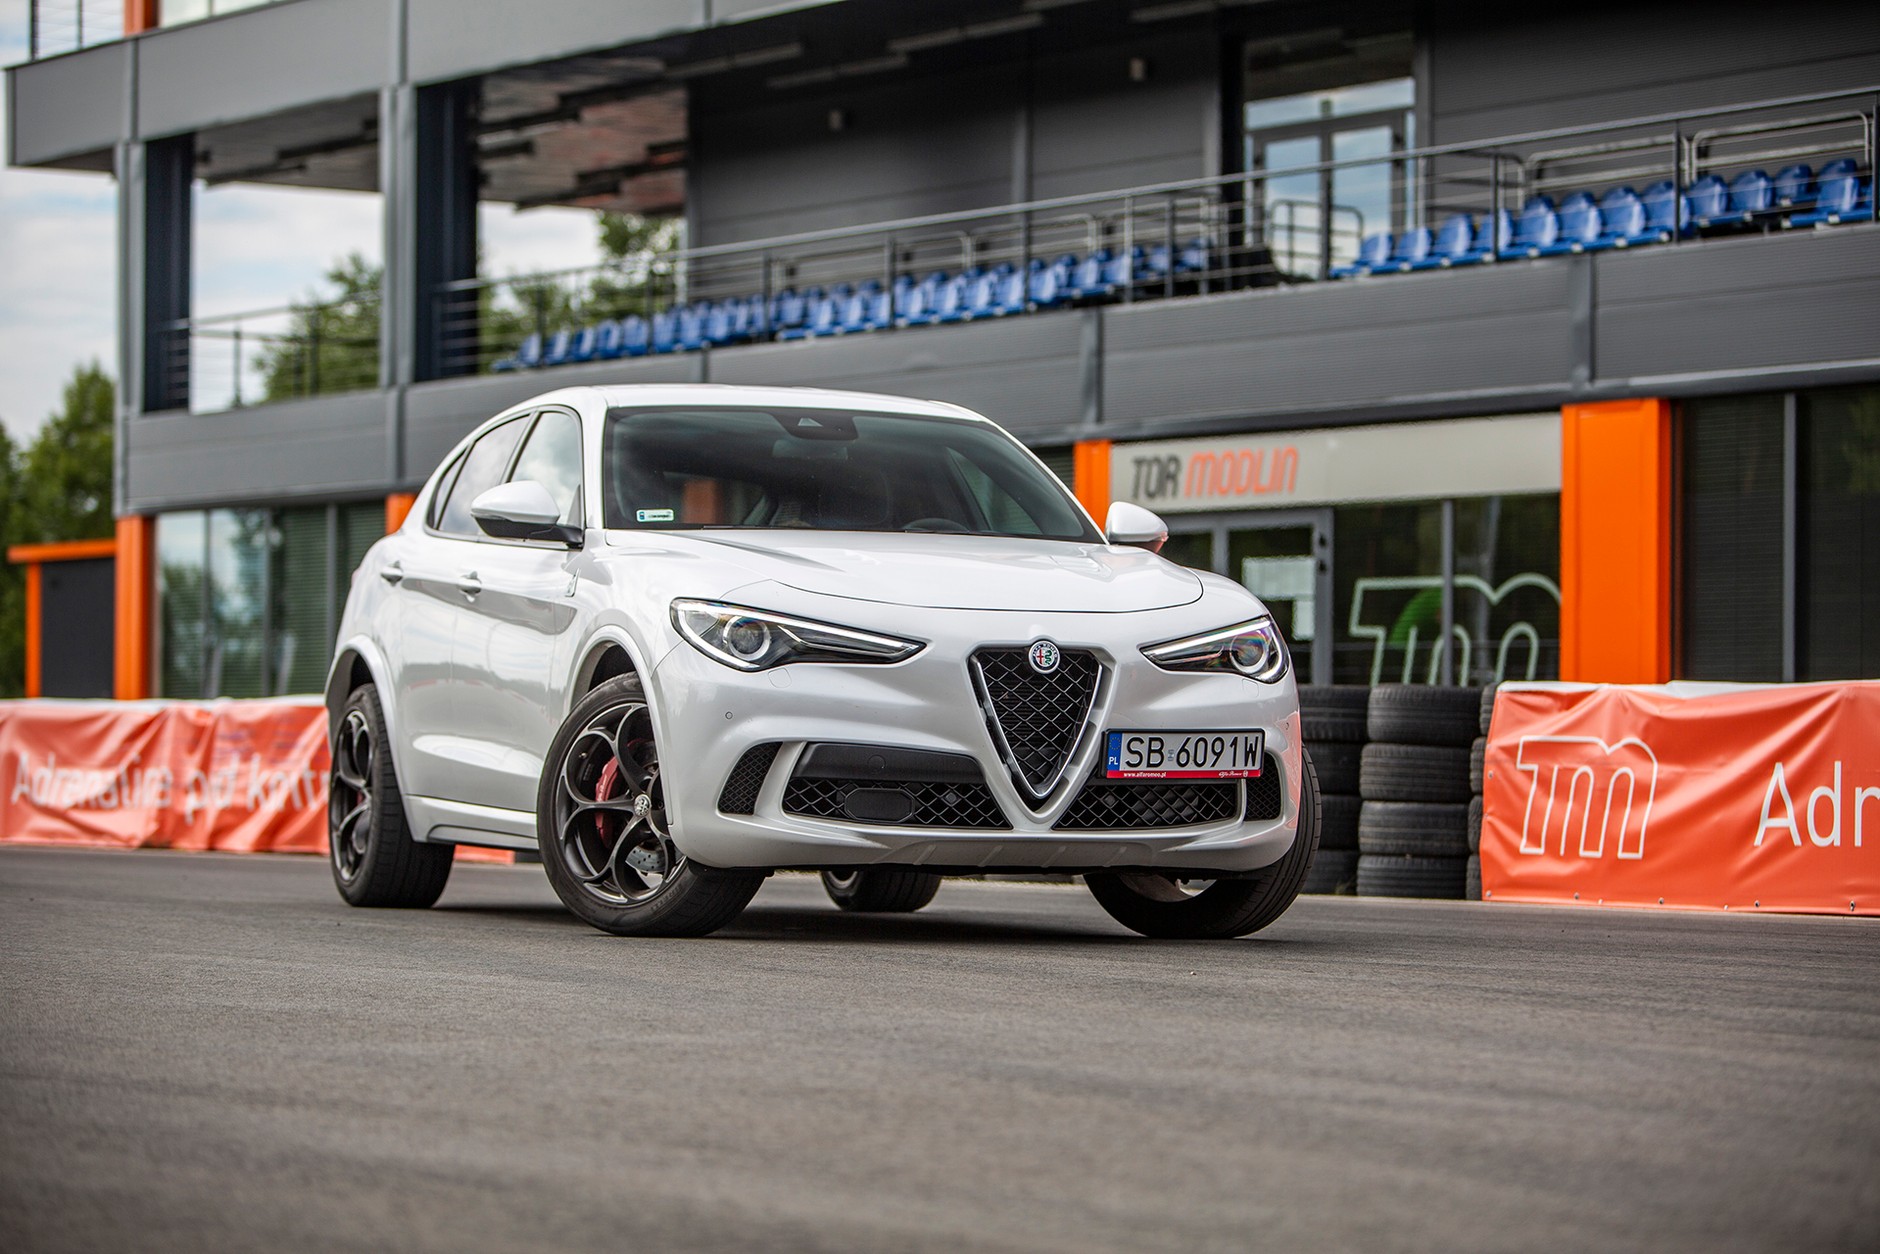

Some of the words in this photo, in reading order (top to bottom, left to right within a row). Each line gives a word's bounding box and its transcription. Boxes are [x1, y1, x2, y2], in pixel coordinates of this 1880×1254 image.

[1132, 454, 1181, 499] TOR
[1184, 445, 1299, 498] MODLIN
[1108, 756, 1119, 766] PL
[1125, 736, 1166, 769] SB
[1175, 735, 1259, 768] 6091W
[1753, 760, 1880, 847] Adr
